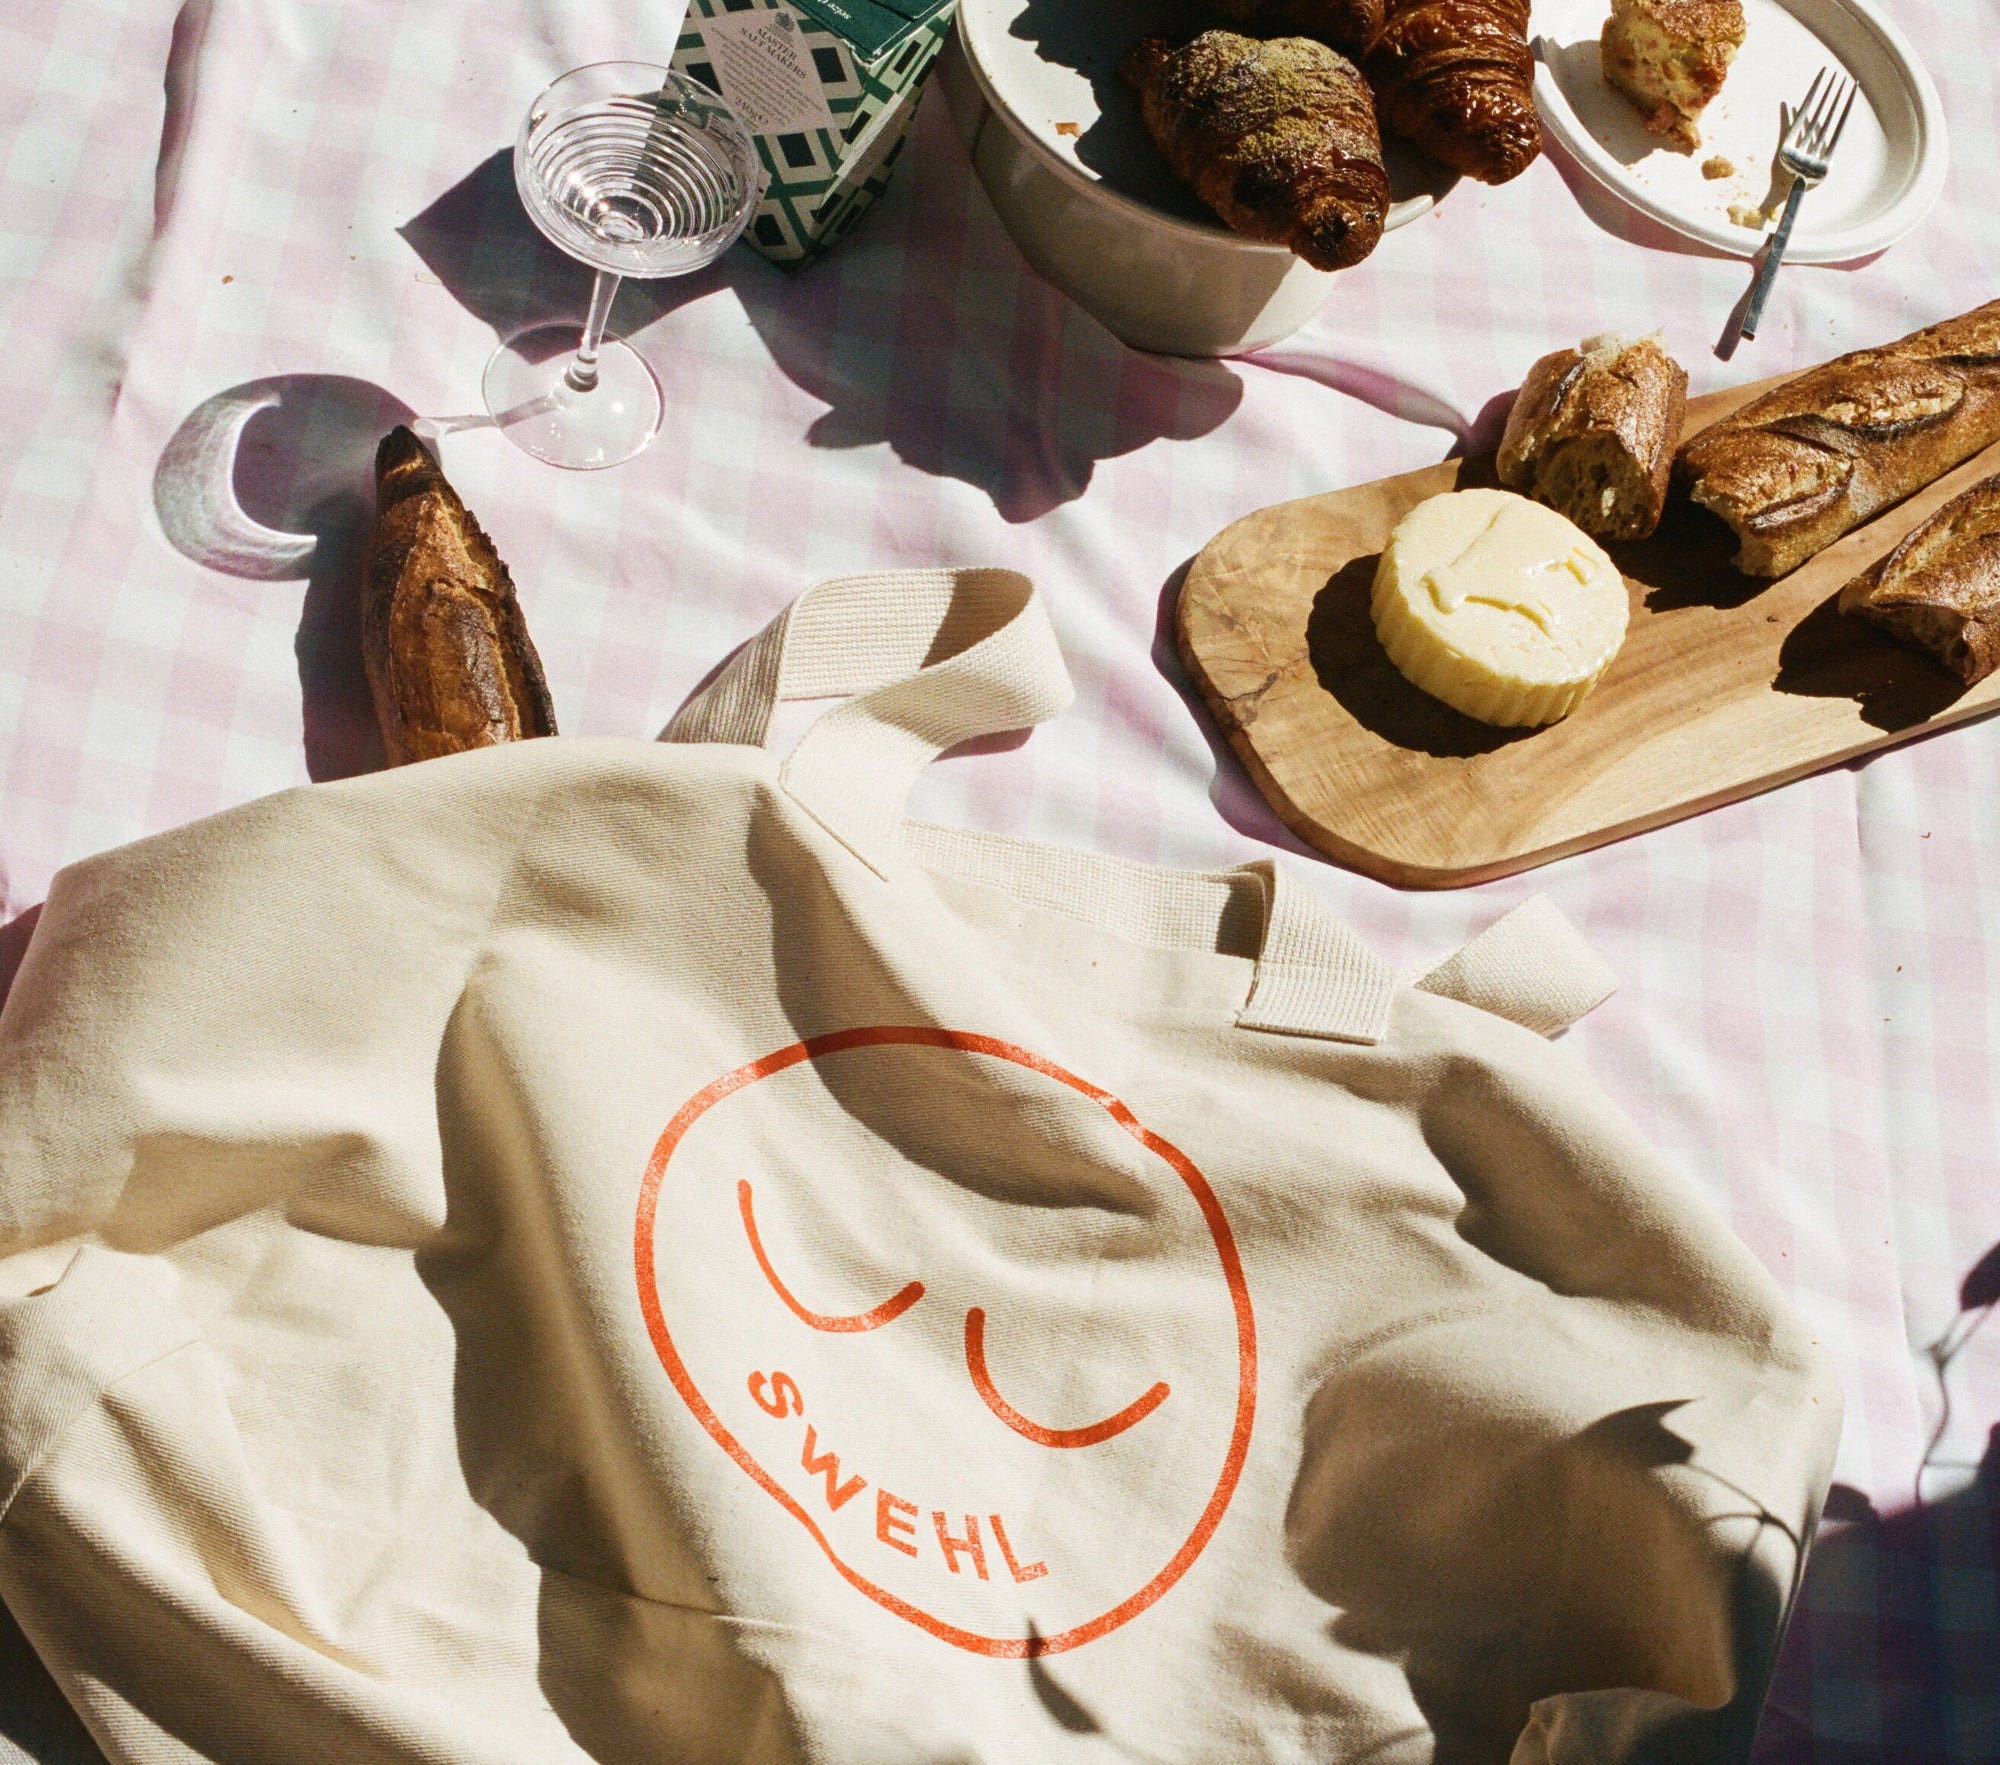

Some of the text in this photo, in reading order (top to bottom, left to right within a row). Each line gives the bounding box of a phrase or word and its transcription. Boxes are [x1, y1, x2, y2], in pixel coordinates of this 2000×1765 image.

[740, 27, 767, 47] SALT
[766, 45, 808, 79] MAKERS
[758, 28, 798, 61] MASTER
[747, 1370, 1049, 1583] SWEHL
